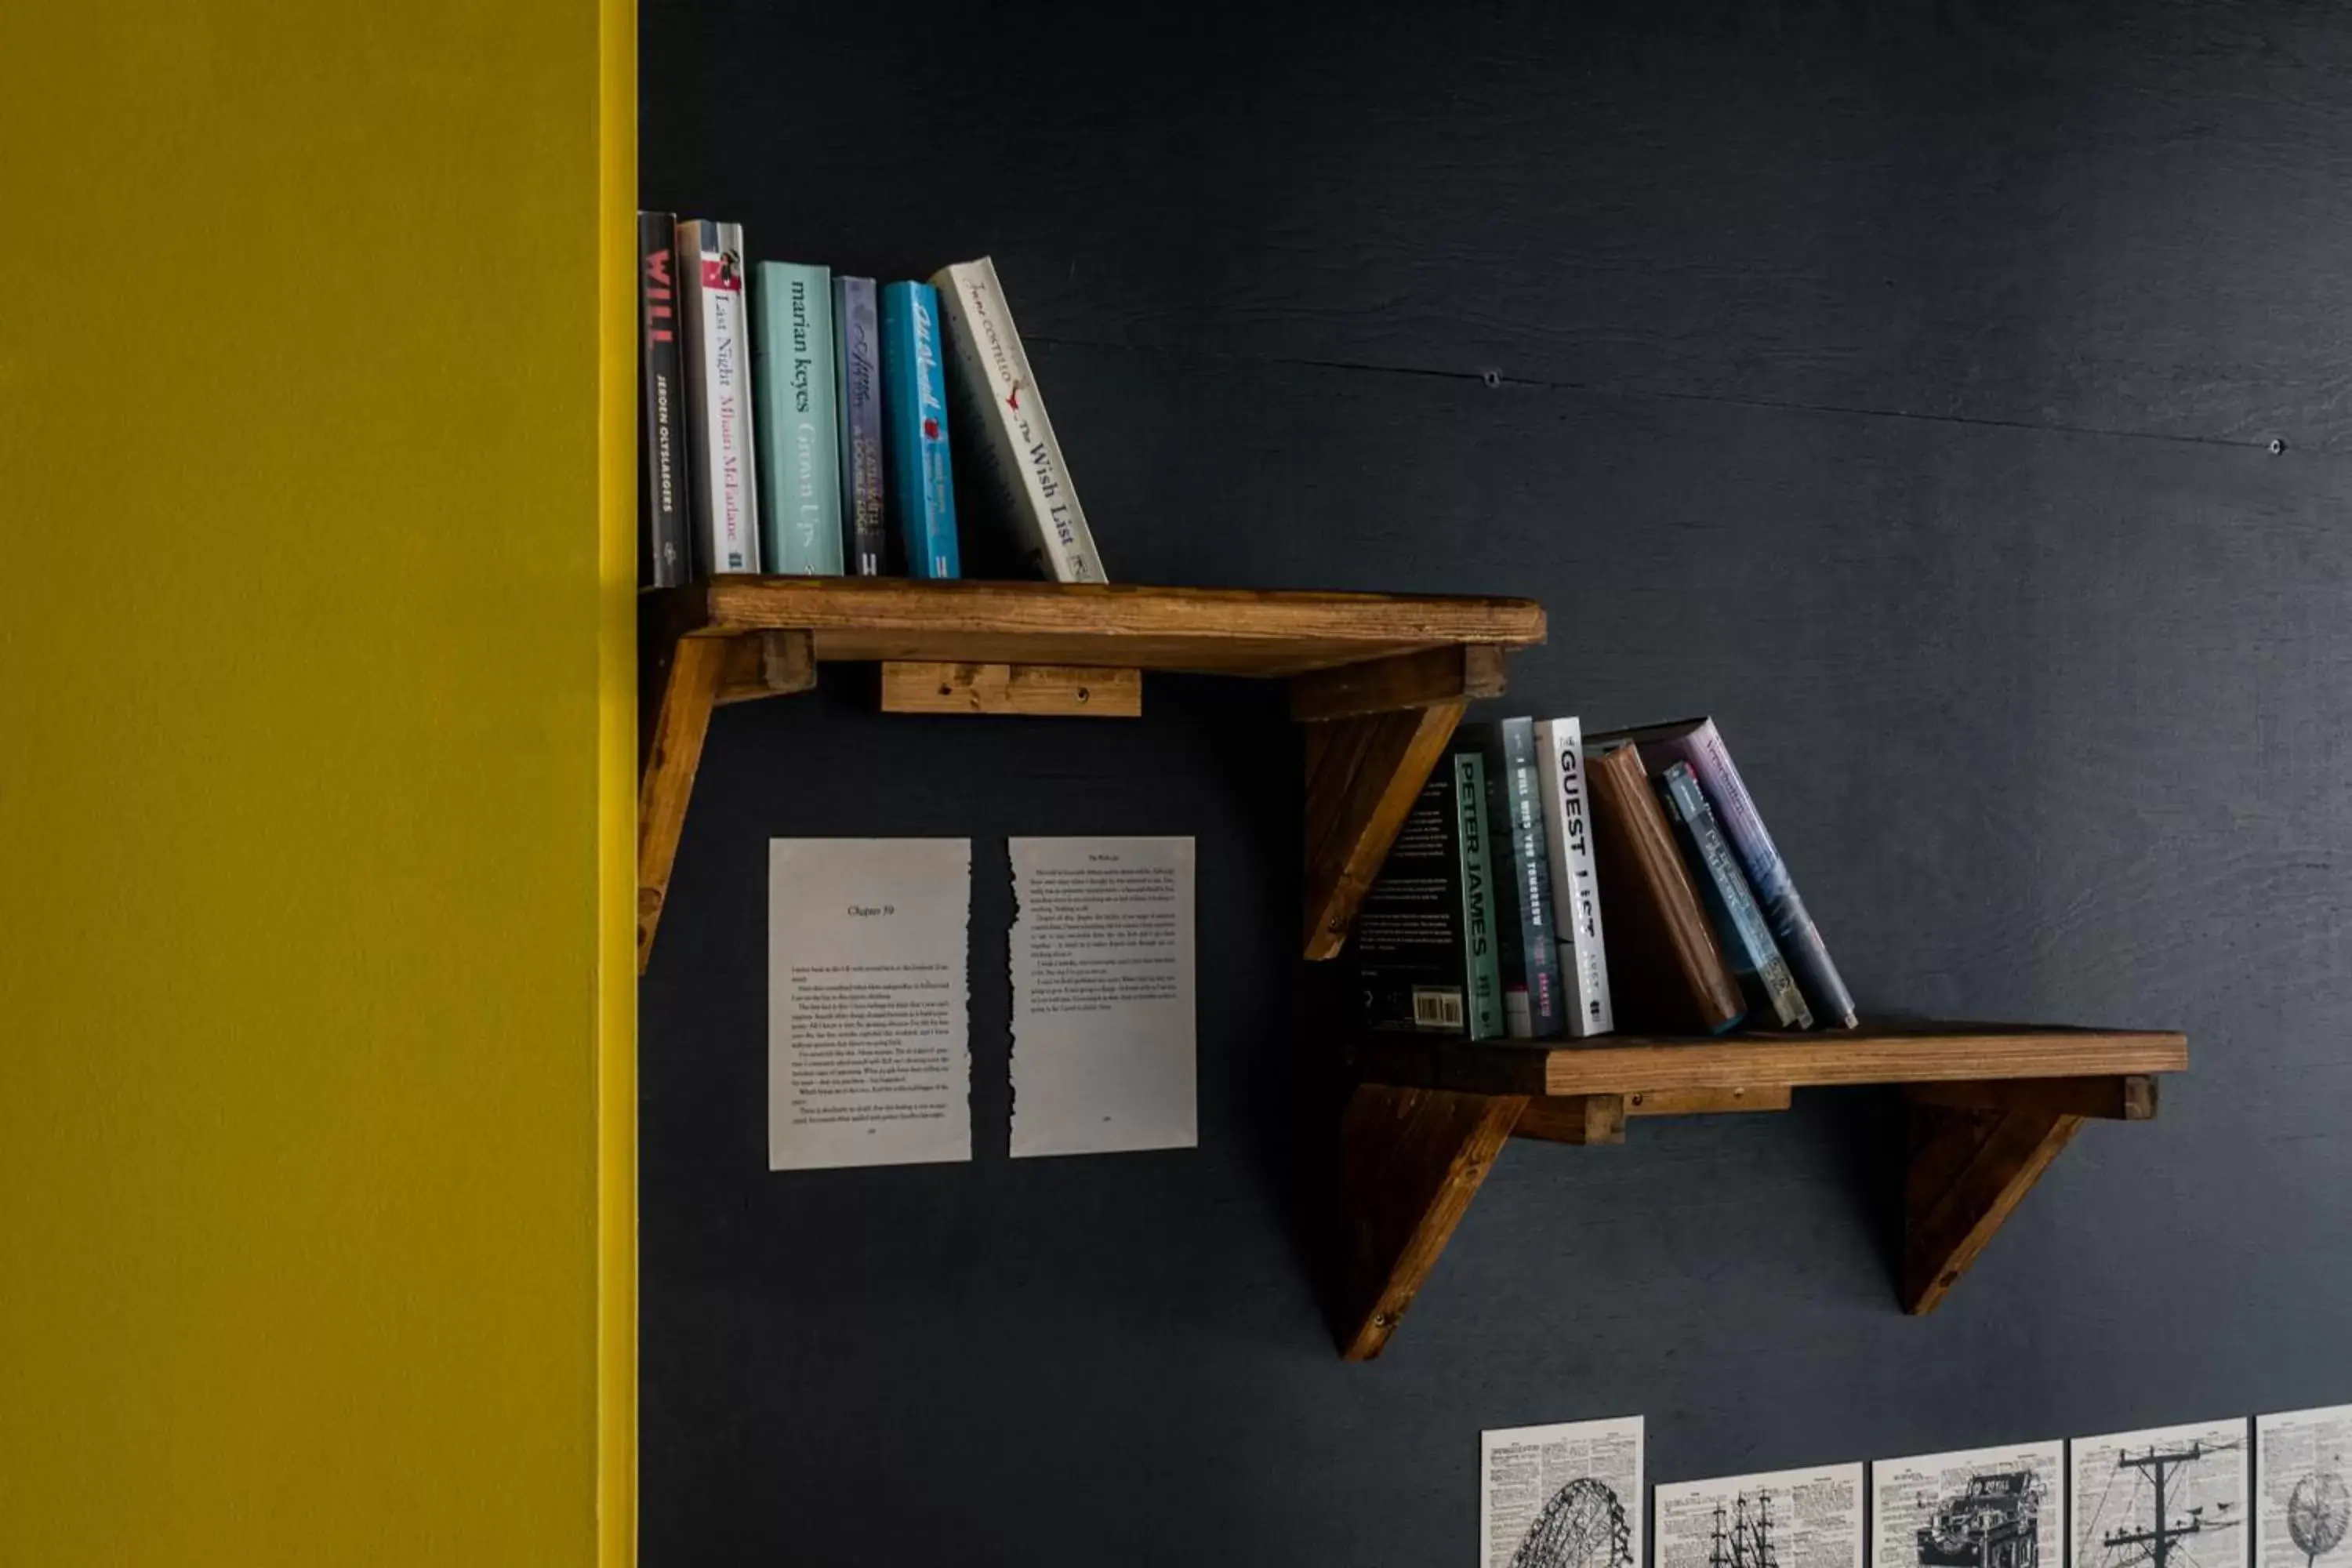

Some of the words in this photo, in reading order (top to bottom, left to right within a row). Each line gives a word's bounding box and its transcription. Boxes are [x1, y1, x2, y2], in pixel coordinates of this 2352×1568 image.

[646, 249, 673, 350] WILL
[715, 294, 729, 330] Last
[791, 281, 810, 352] marian
[717, 337, 733, 387] Night
[790, 358, 812, 413] keyes
[982, 318, 1011, 383] COSTELLO
[657, 374, 669, 423] JEROEN
[797, 423, 816, 497] Grown
[1018, 418, 1032, 445] The
[1029, 441, 1055, 500] Wish
[1049, 503, 1074, 546] List
[724, 456, 739, 542] McFarlane
[797, 504, 819, 547] Ups
[1461, 761, 1479, 855] PETER
[1561, 749, 1586, 857] GUEST
[1517, 768, 1528, 796] WILL
[1527, 862, 1543, 926] TOMORROW
[1467, 864, 1487, 957] JAMES
